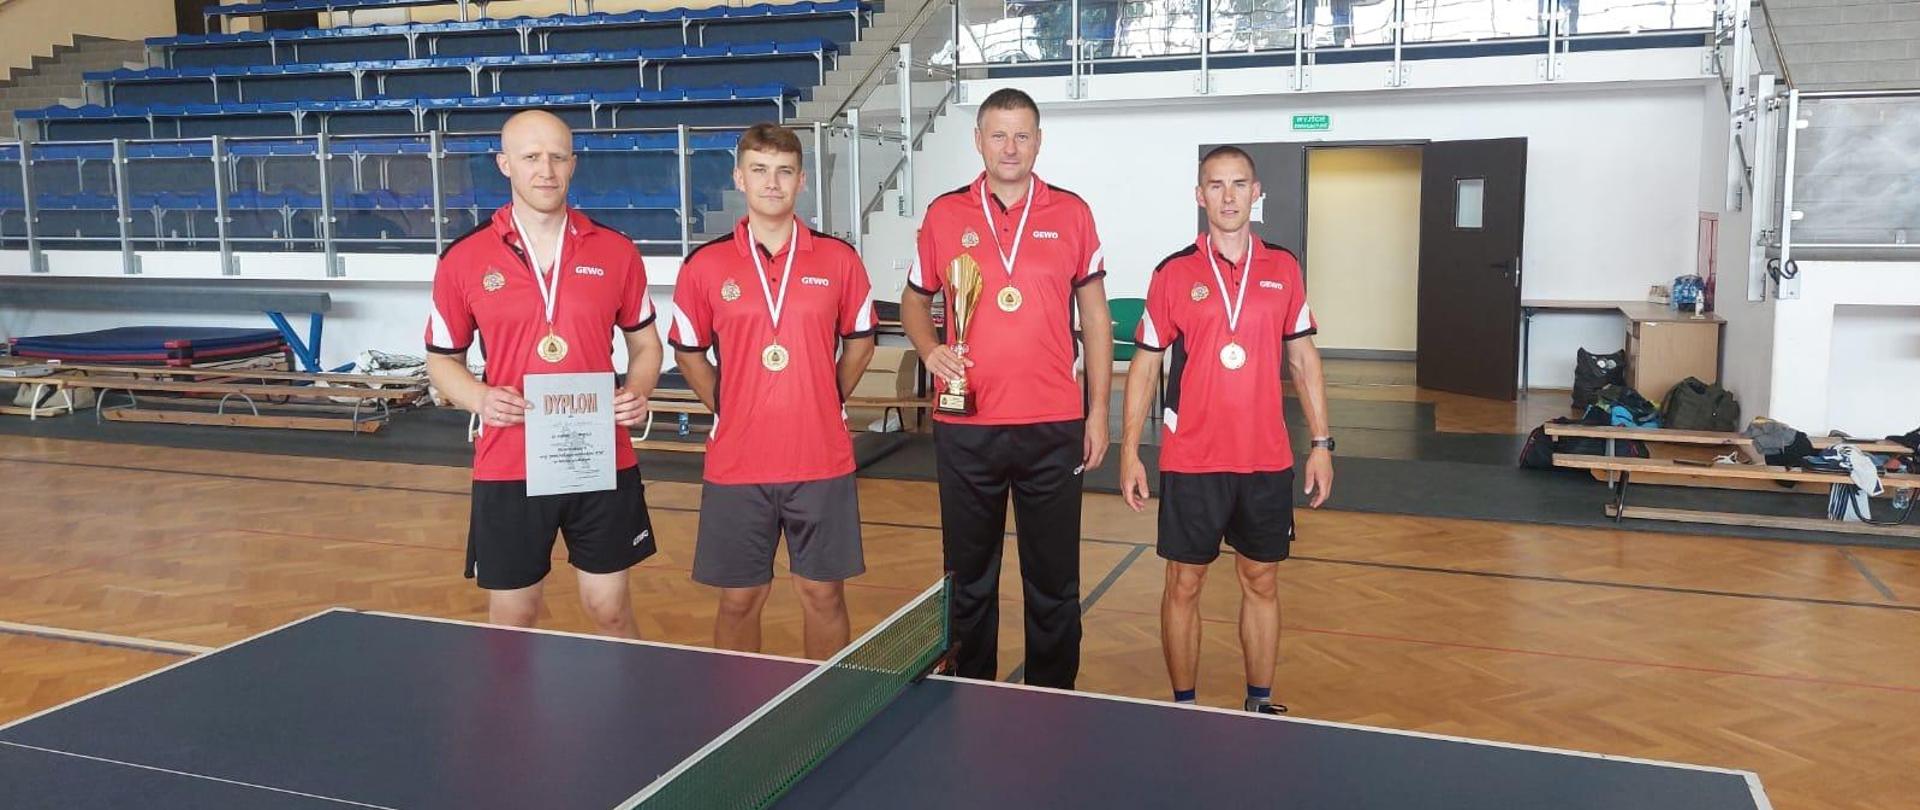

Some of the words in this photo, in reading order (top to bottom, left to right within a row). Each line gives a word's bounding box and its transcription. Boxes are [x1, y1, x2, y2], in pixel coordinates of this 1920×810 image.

[1032, 230, 1059, 239] GEWO
[575, 266, 604, 277] GEWO
[801, 276, 829, 287] GEWO
[543, 392, 598, 415] DYPLOM
